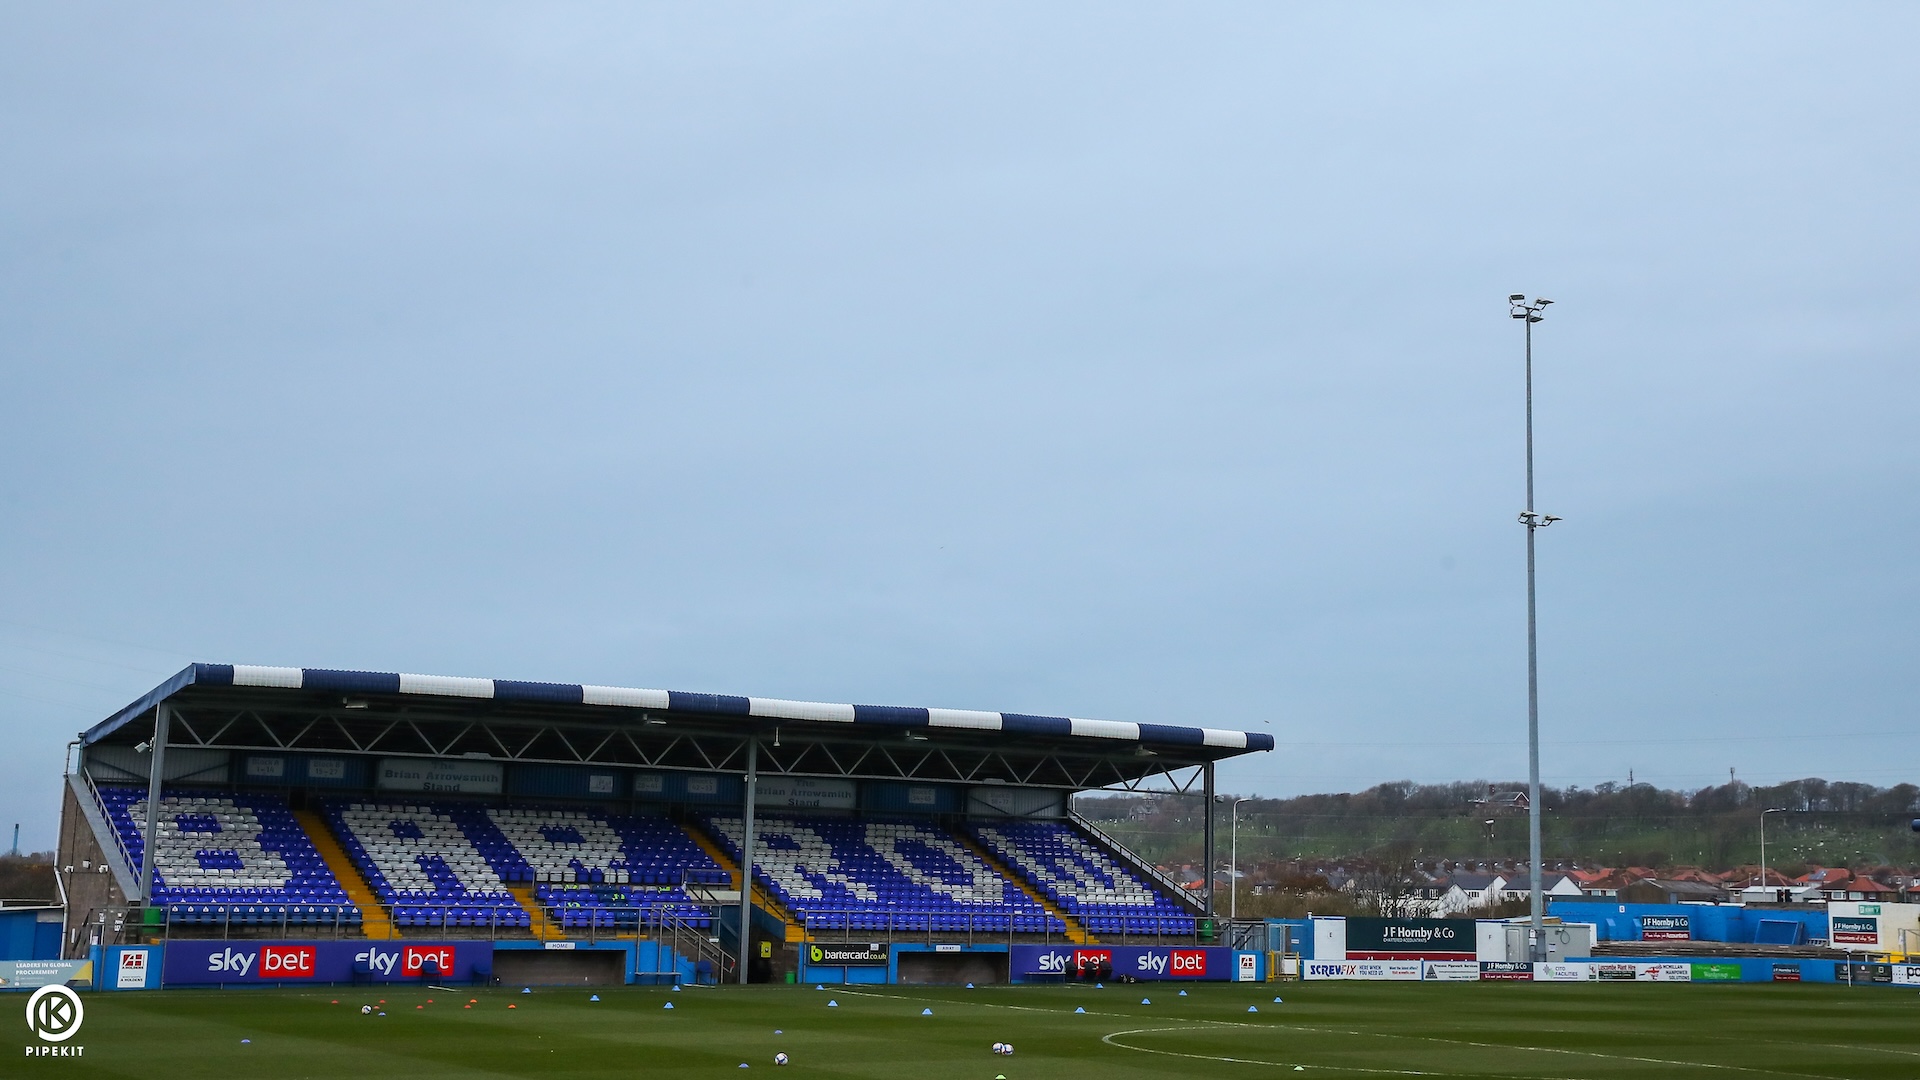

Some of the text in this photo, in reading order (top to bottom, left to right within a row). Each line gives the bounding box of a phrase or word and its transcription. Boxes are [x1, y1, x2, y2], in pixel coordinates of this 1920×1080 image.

[431, 761, 456, 770] The
[385, 769, 499, 783] Brian Arrowsmith
[423, 782, 461, 792] Stand
[795, 779, 816, 787] The
[755, 787, 852, 799] Brian Arrowsmith
[788, 798, 820, 807] Stand
[1652, 918, 1675, 928] Hornby
[1680, 918, 1689, 927] Co
[1842, 923, 1861, 931] Hornby
[1383, 926, 1455, 941] J F Hornby & Co
[208, 946, 310, 976] sky bet
[824, 949, 887, 961] bartercard.co.uk
[1038, 950, 1072, 975] sky
[1137, 950, 1203, 975] sky bet
[1494, 962, 1515, 971] Hornby
[1310, 965, 1357, 977] SCREWFIX
